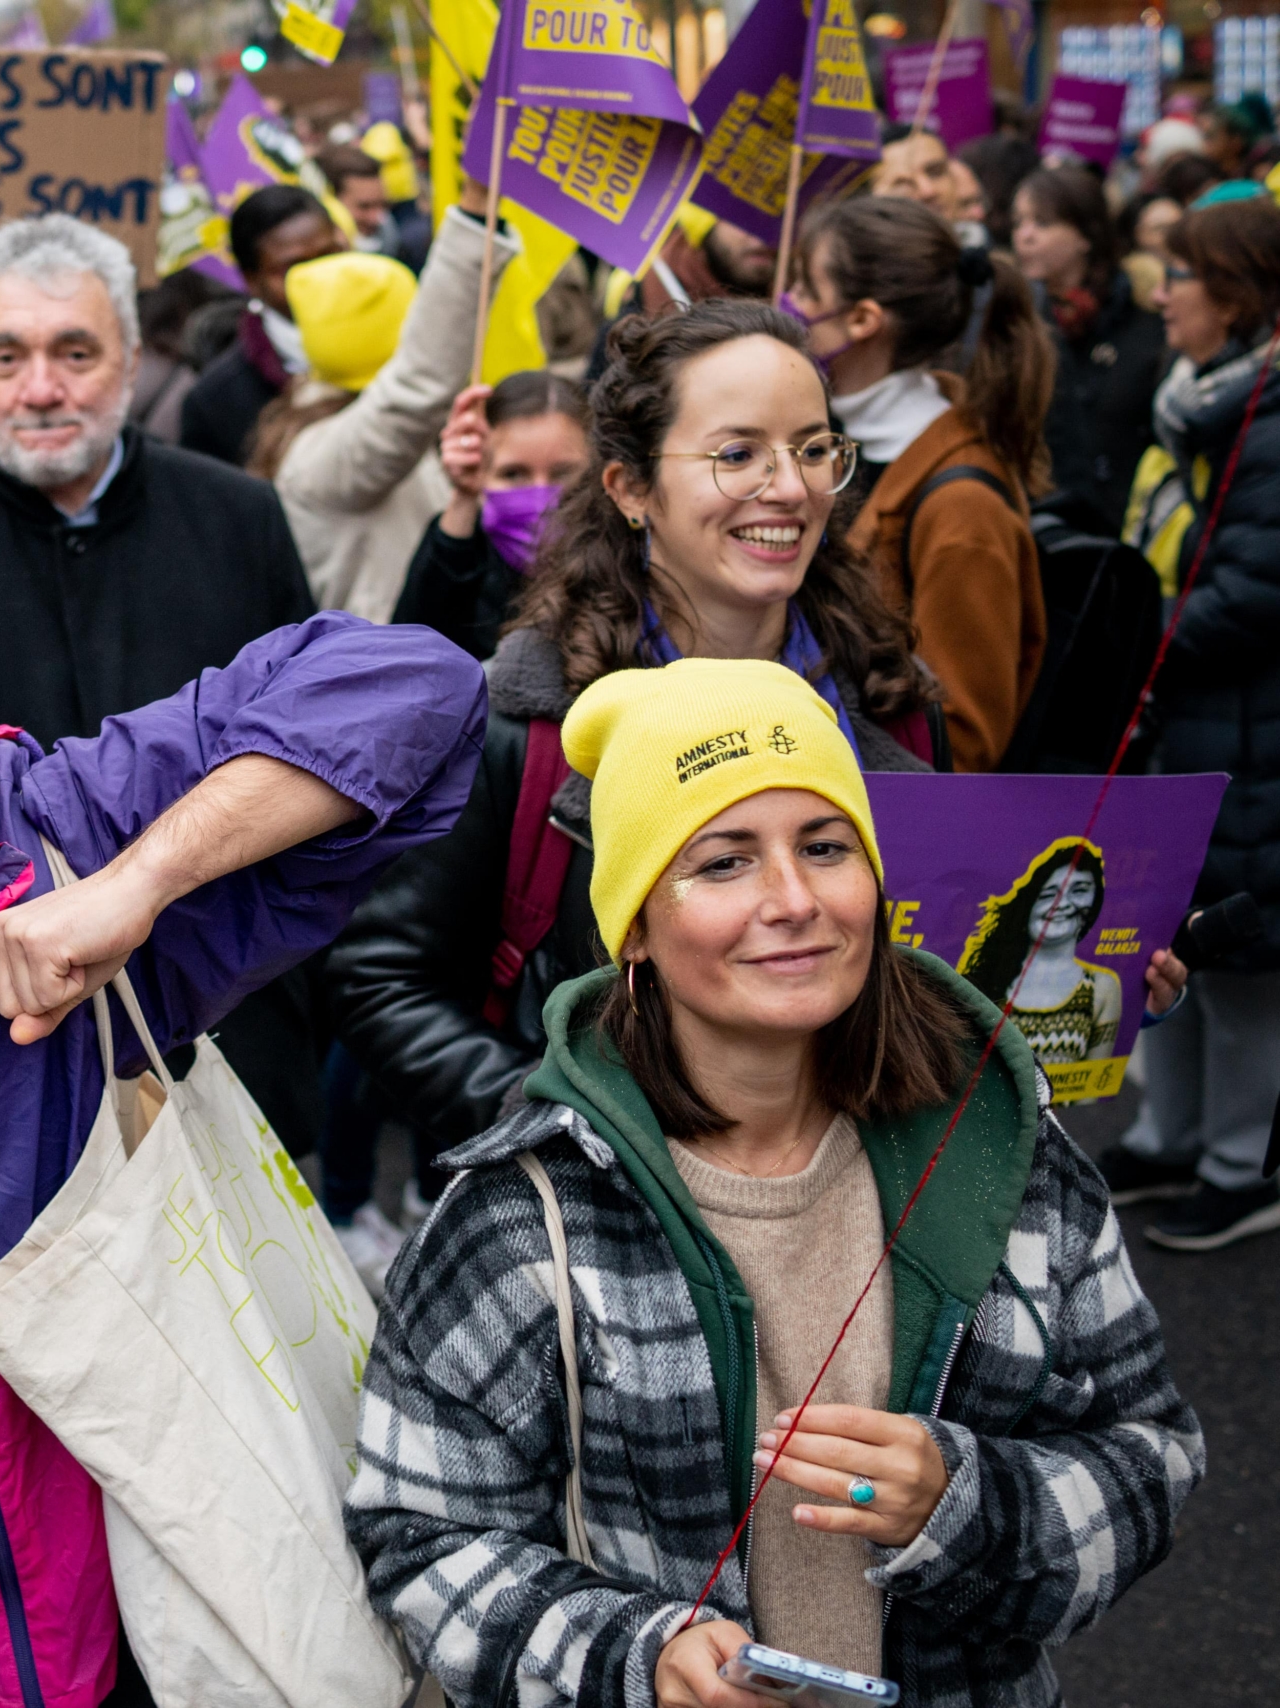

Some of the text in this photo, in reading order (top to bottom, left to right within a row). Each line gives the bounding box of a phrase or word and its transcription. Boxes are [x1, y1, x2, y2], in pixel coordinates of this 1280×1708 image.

[531, 9, 608, 46] POUR
[36, 53, 163, 113] SONT
[508, 105, 553, 165] TOU
[598, 135, 648, 214] POUR
[28, 173, 157, 225] SONT
[676, 730, 748, 772] AMNESTY
[678, 746, 754, 784] INTERNATIONAL
[1099, 927, 1139, 941] WENDY
